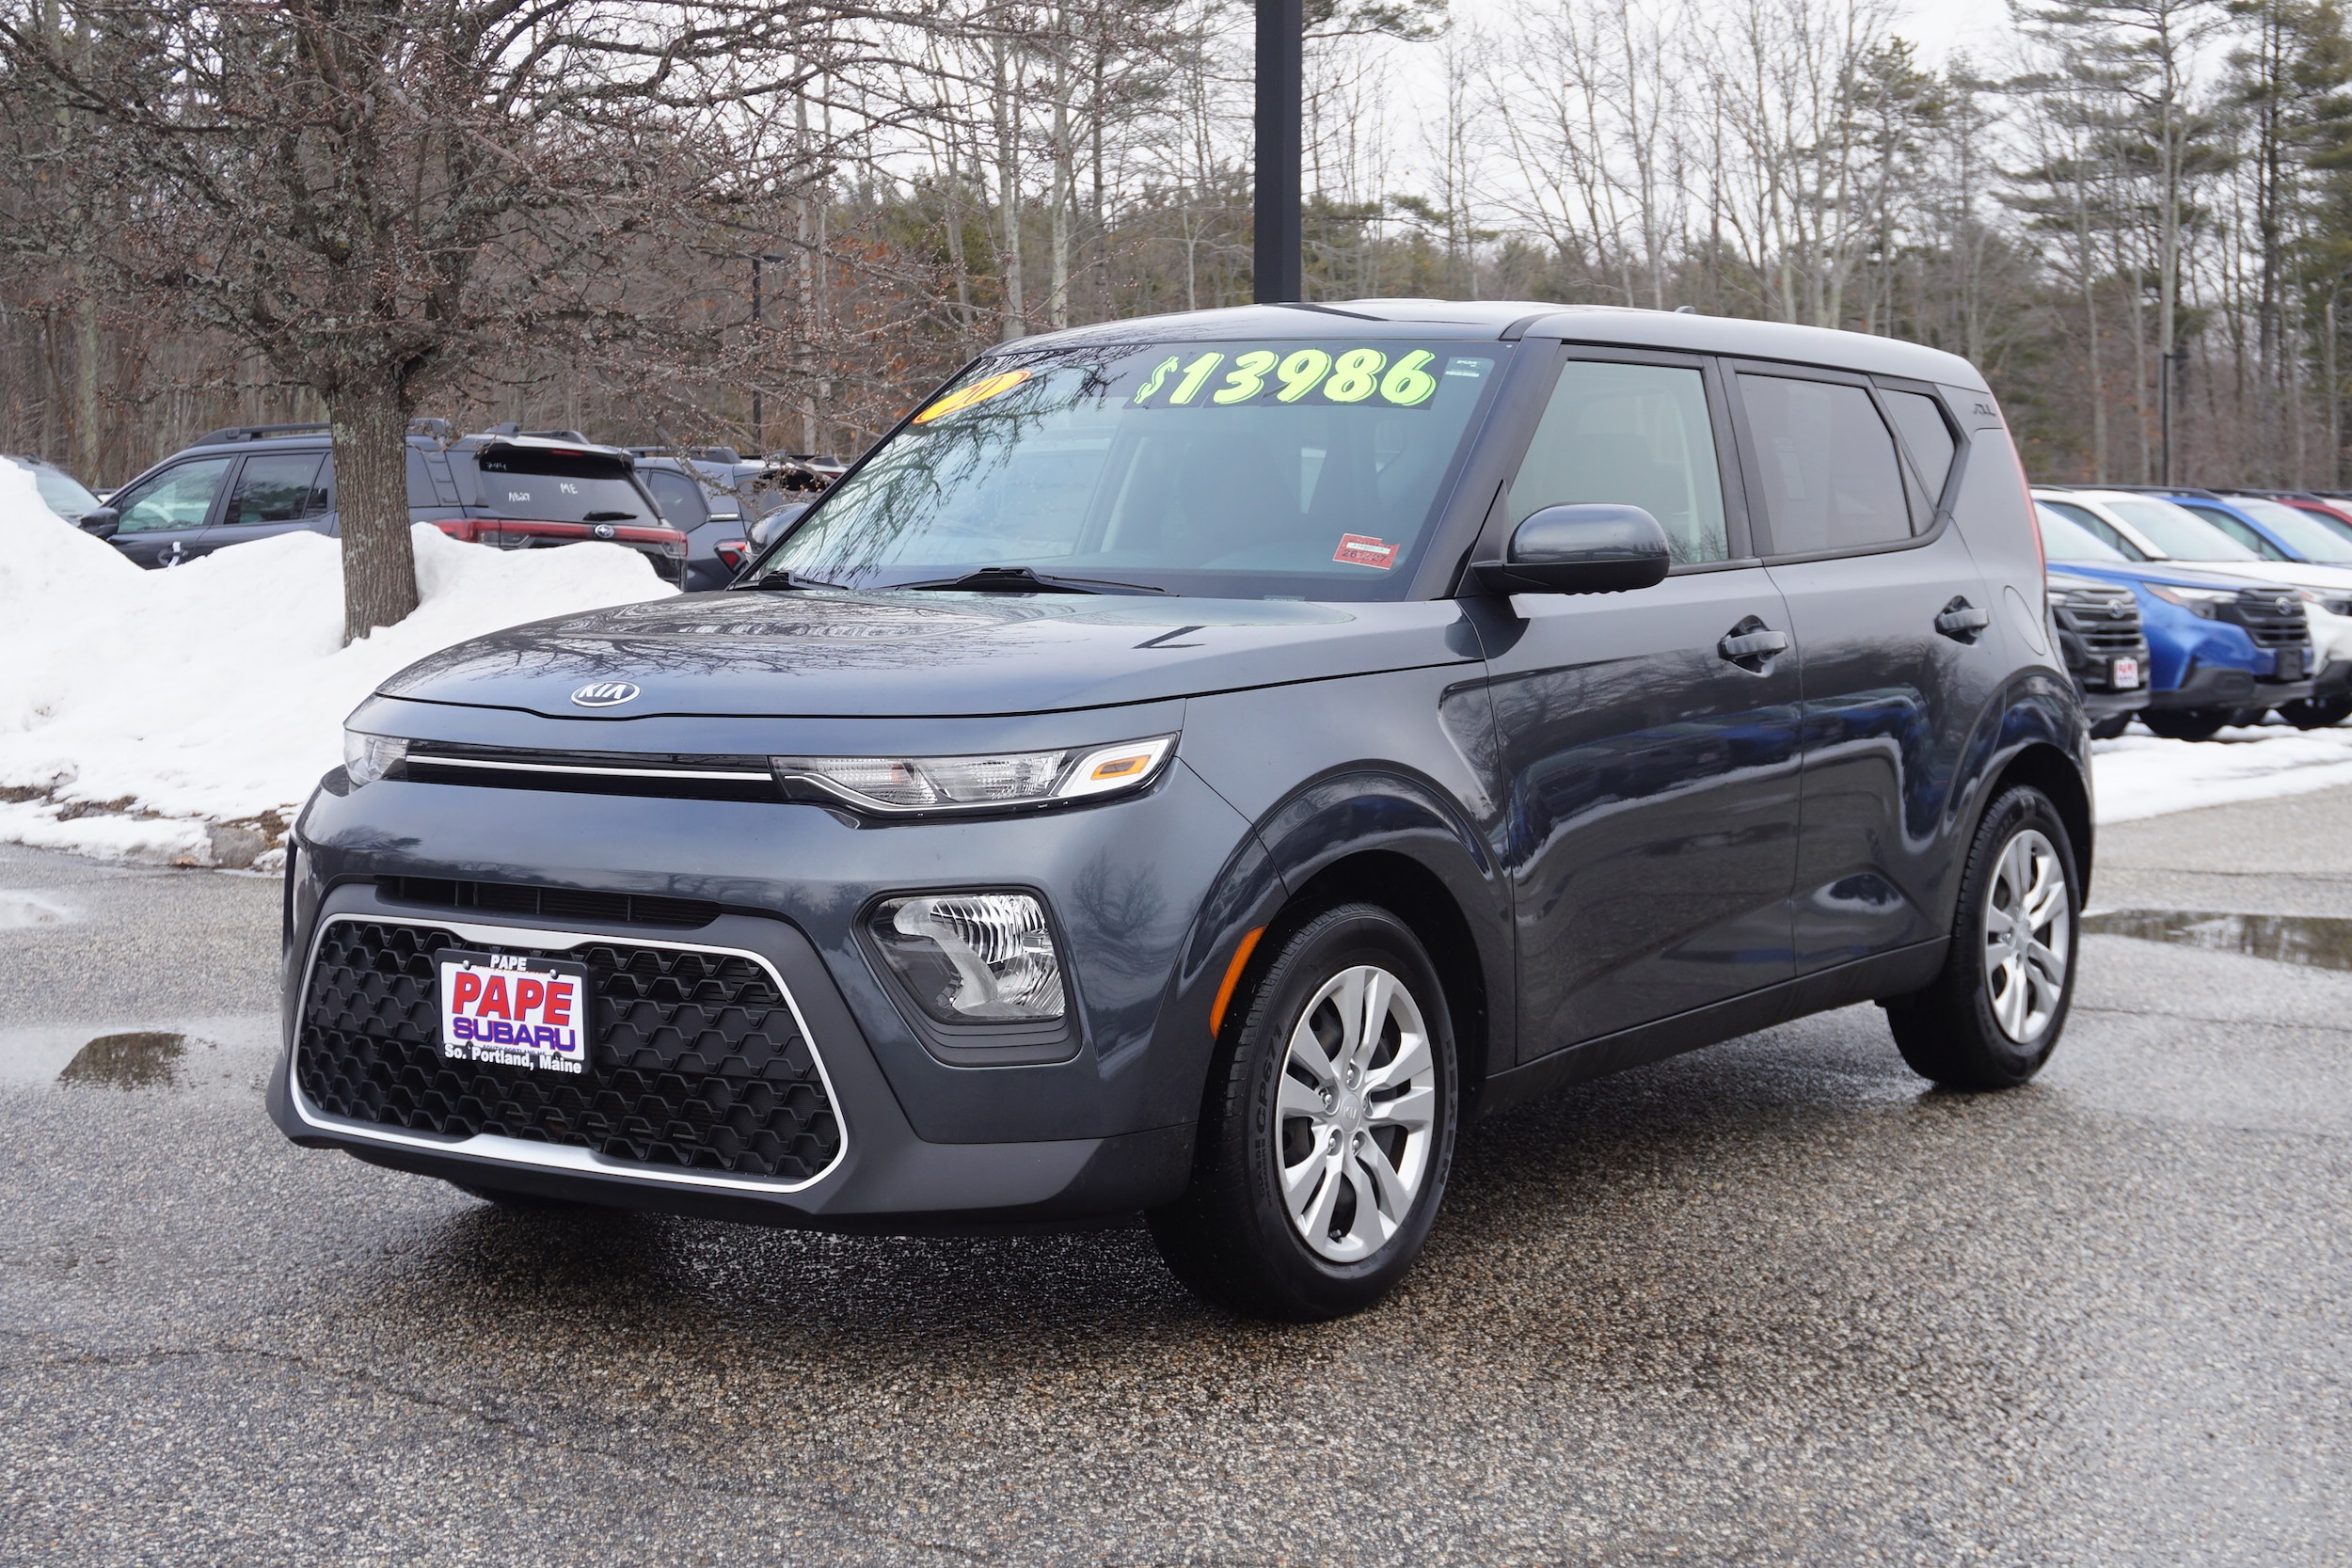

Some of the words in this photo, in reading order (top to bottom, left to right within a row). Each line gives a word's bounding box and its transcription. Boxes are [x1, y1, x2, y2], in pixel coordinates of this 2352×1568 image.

[1134, 348, 1437, 405] $13986
[578, 683, 628, 699] KIA
[490, 954, 528, 971] PAPE
[452, 972, 574, 1026] PAPE
[453, 1017, 576, 1053] SUBARU
[444, 1045, 467, 1059] So.
[471, 1047, 534, 1070] Portland,
[539, 1054, 582, 1074] Maine
[1255, 1022, 1282, 1134] CP671
[1440, 1037, 1457, 1186] NEXEN
